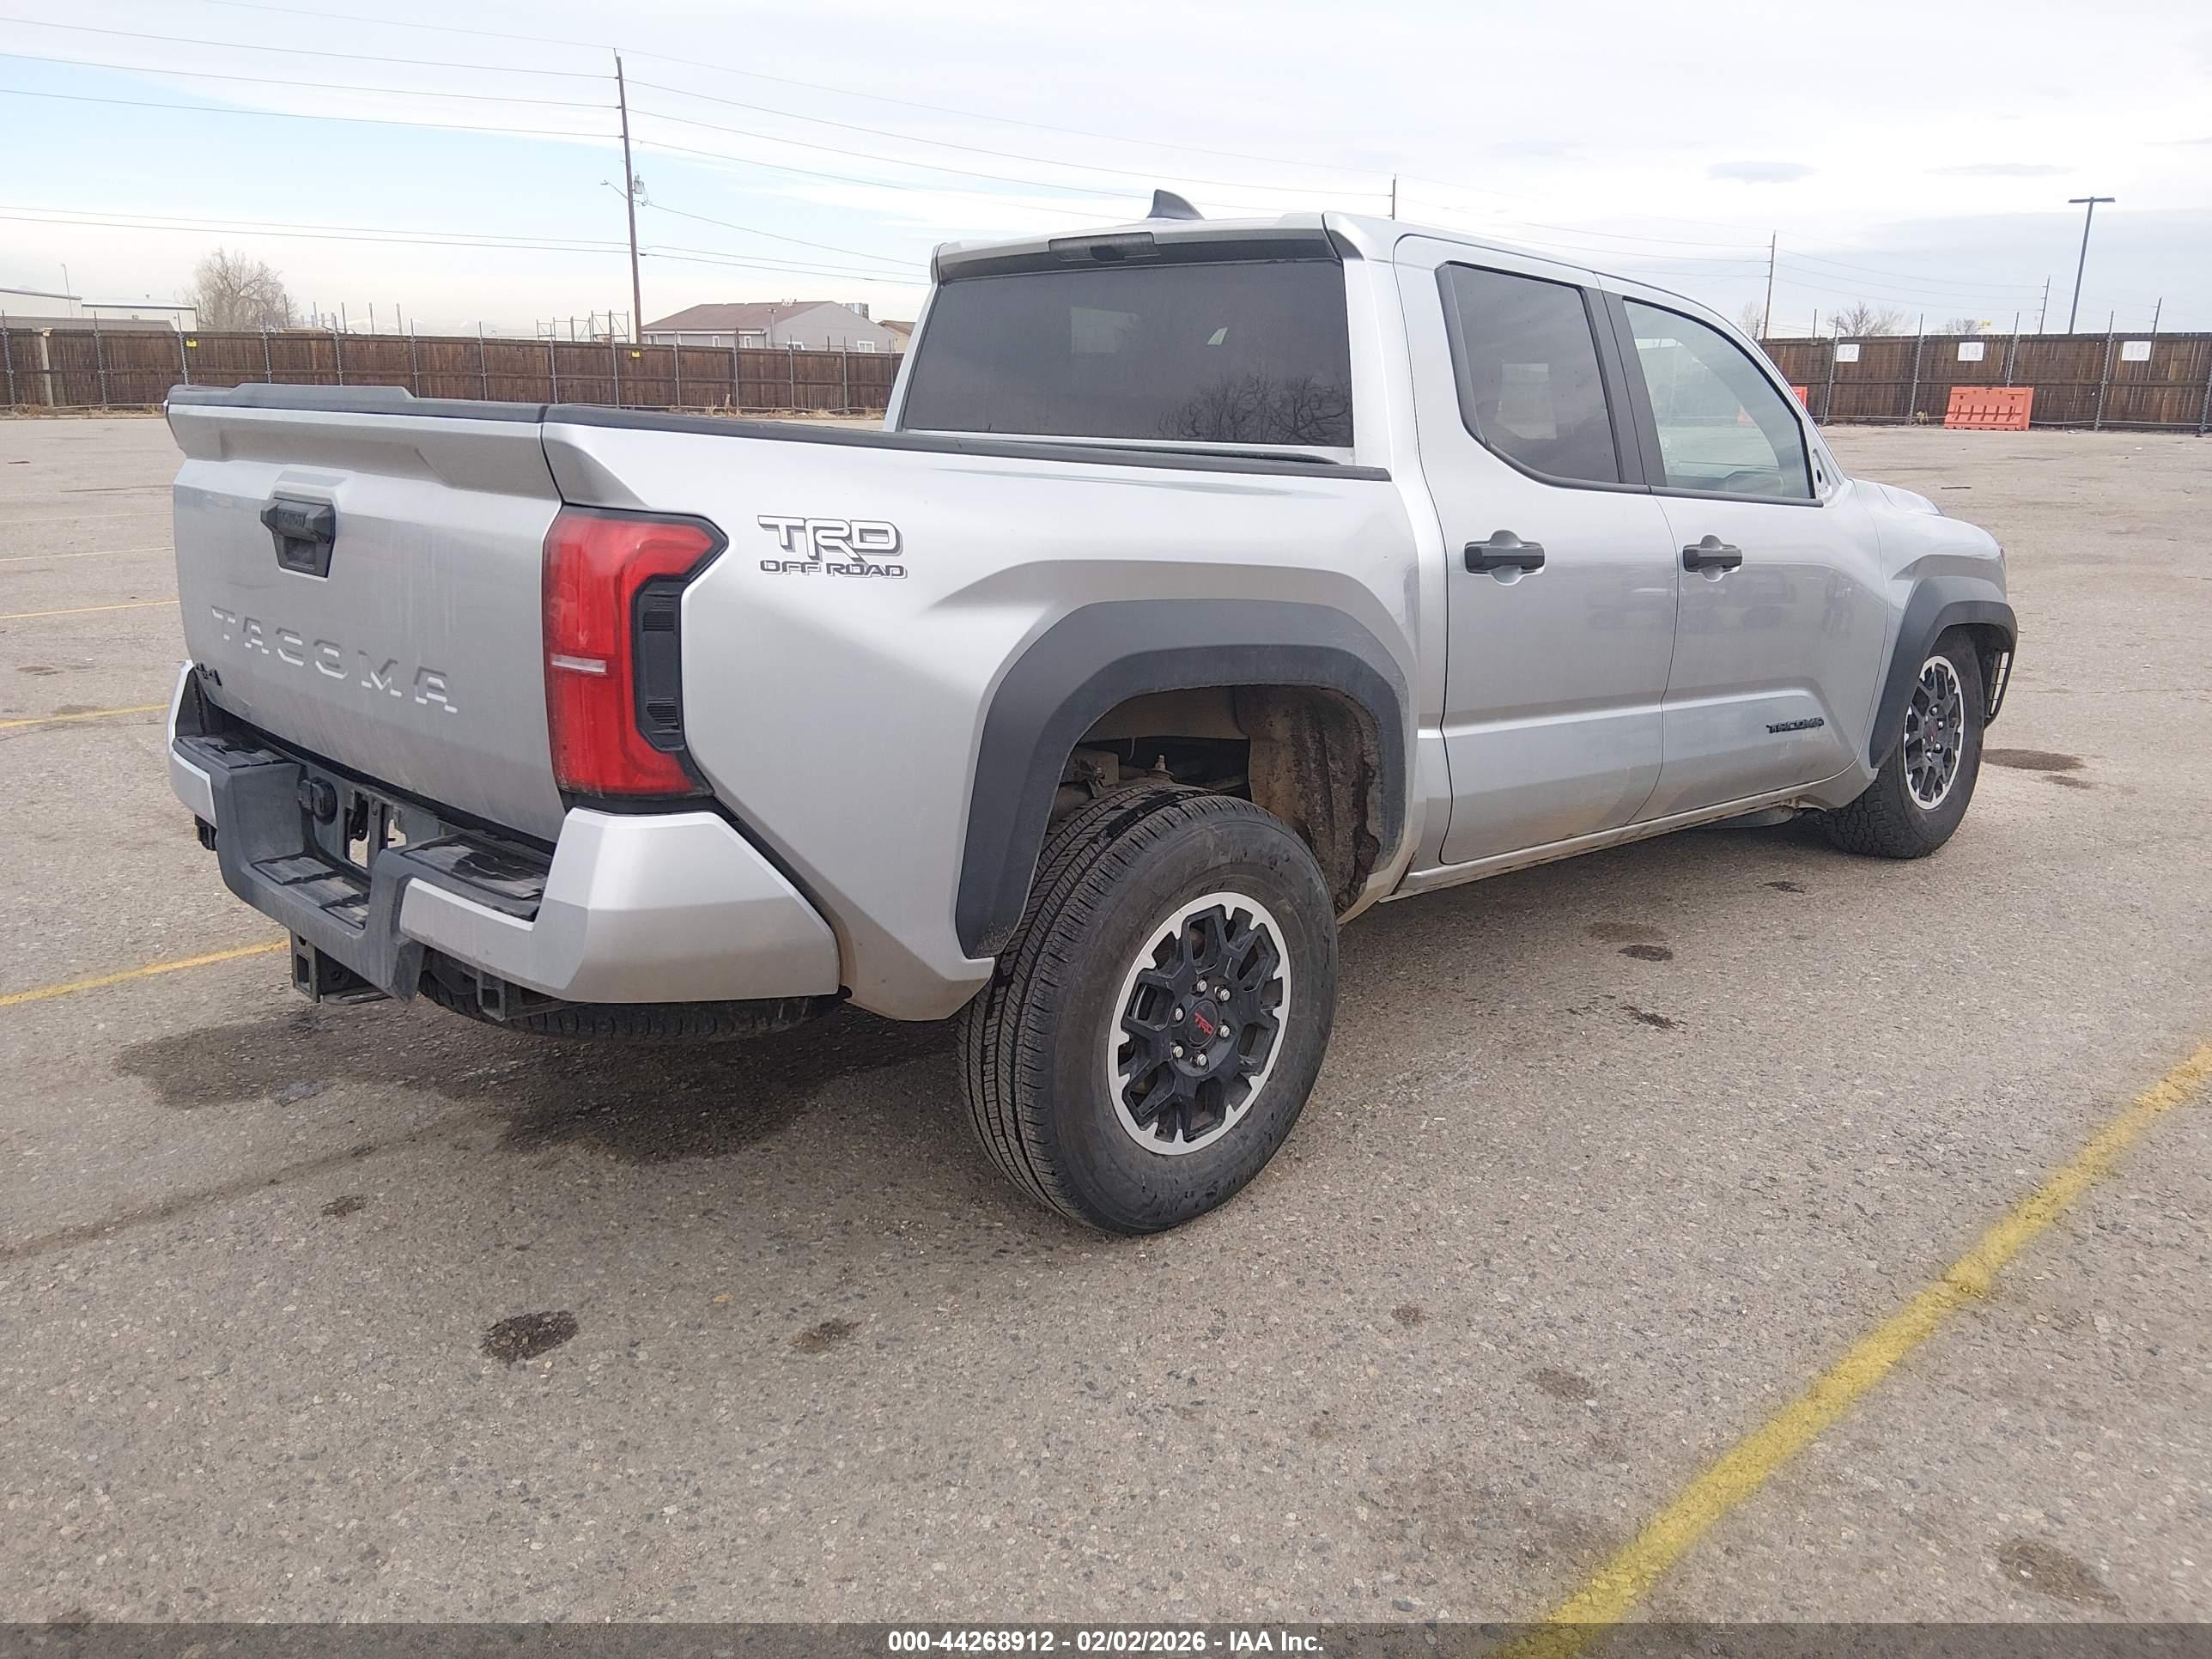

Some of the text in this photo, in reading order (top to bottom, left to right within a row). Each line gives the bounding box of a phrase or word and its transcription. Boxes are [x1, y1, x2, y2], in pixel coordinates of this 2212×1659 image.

[1841, 347, 1856, 358] 12
[1963, 345, 1978, 358] 14
[2129, 343, 2146, 358] 16
[757, 515, 903, 565] TRD
[760, 560, 908, 579] OFF ROAD
[211, 605, 458, 714] TACOMA
[1194, 1012, 1214, 1036] TRD
